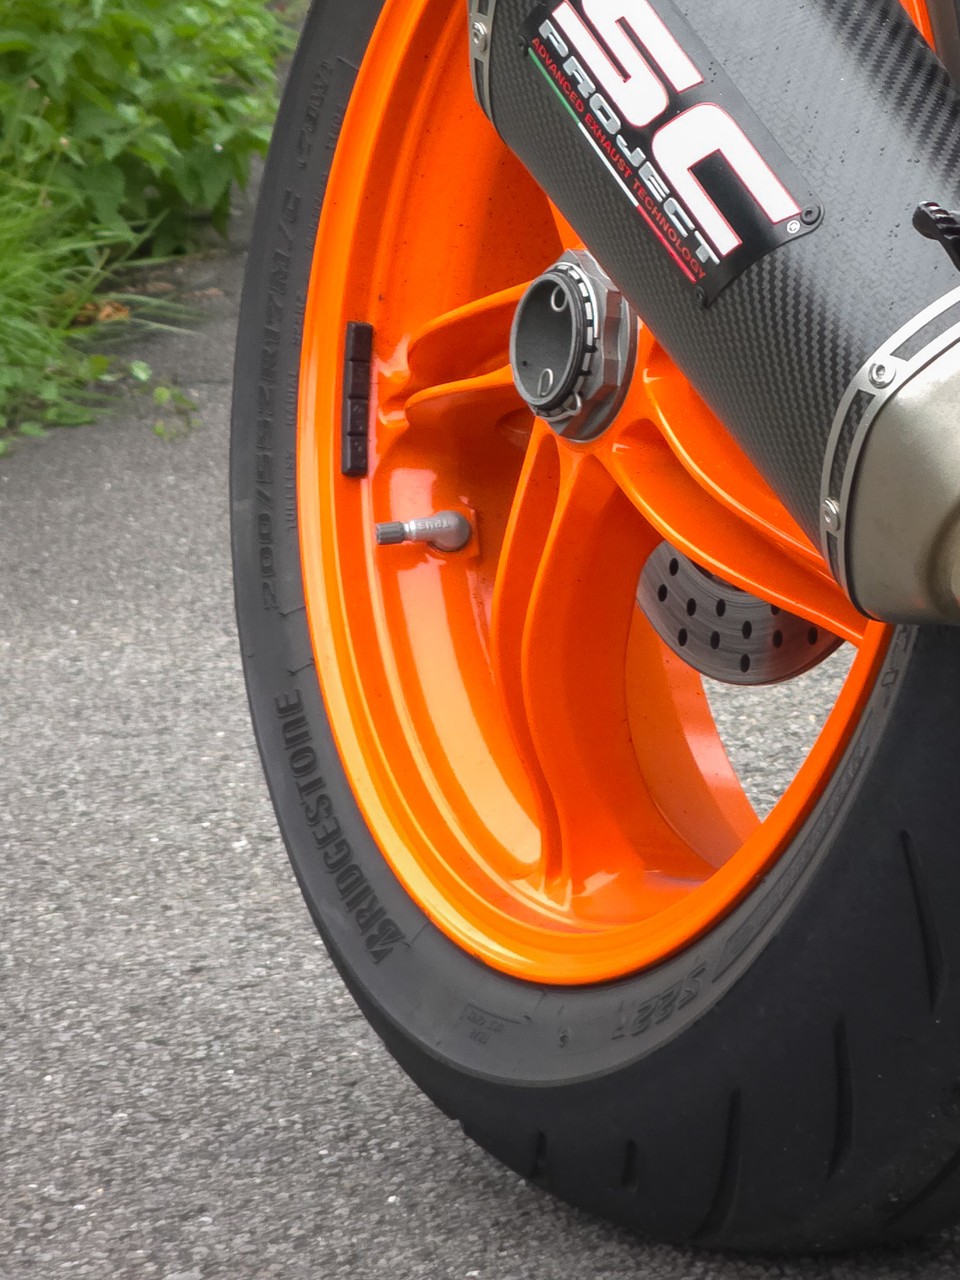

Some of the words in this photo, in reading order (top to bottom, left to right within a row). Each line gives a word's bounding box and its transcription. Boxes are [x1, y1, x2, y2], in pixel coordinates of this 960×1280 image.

[531, 37, 585, 113] ADVANCED
[584, 112, 633, 178] EXHAUST
[632, 177, 707, 280] TECHNOLOGY
[538, 19, 720, 265] PROJECT
[273, 688, 406, 965] BRIDGESTONE
